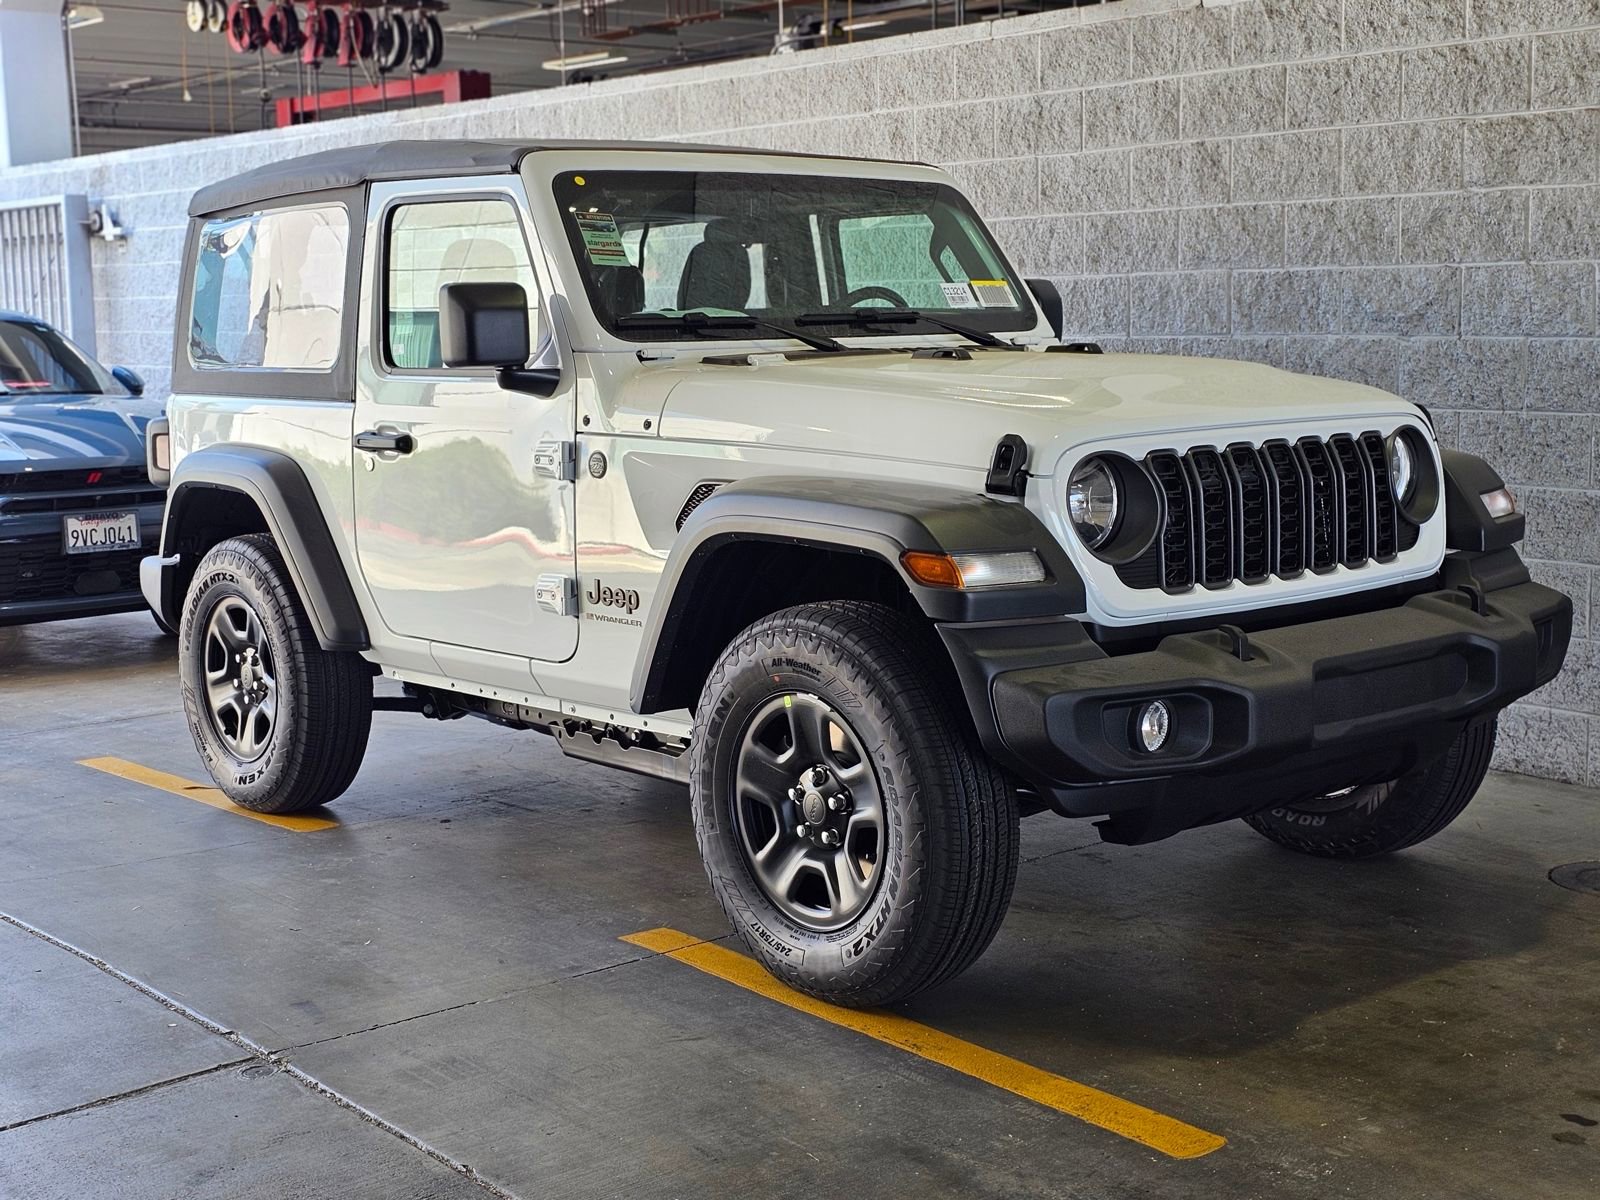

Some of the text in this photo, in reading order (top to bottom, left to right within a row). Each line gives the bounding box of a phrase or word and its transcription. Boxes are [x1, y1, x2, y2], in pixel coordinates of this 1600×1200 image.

[71, 525, 136, 548] 9VCJ041
[184, 572, 236, 644] ROADIAN HTX2
[586, 578, 640, 615] Jeep
[594, 613, 643, 628] WRANGLER
[771, 657, 822, 676] All-Weather
[237, 740, 277, 786] NEXEN
[701, 696, 733, 819] NEXEN
[1271, 807, 1327, 827] ROAD
[750, 922, 793, 958] 245/75R17
[852, 897, 892, 958] HTX2
